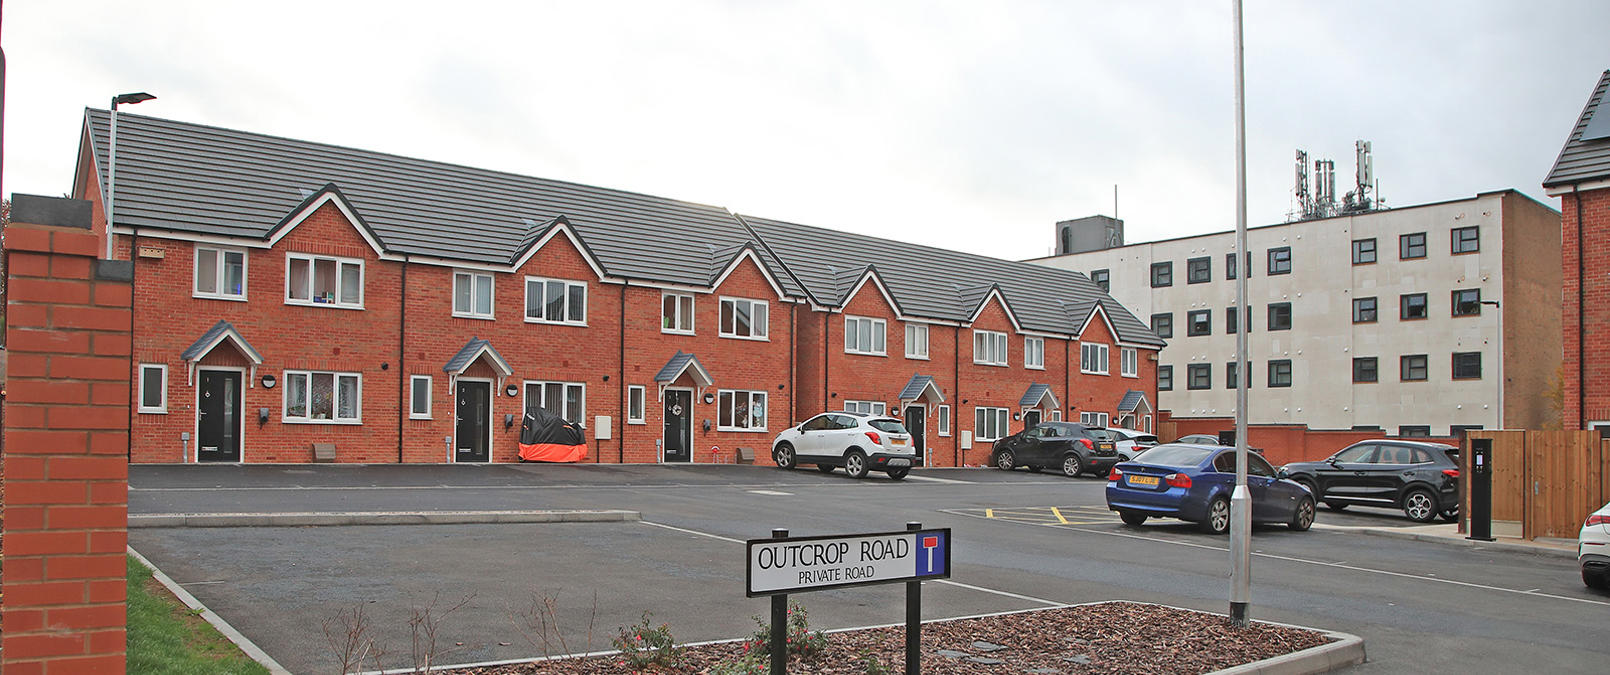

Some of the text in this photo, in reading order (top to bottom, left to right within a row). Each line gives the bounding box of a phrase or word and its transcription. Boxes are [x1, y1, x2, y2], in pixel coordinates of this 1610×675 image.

[758, 538, 909, 569] OUTCROP ROAD
[798, 566, 875, 585] PRIVATE ROAD
